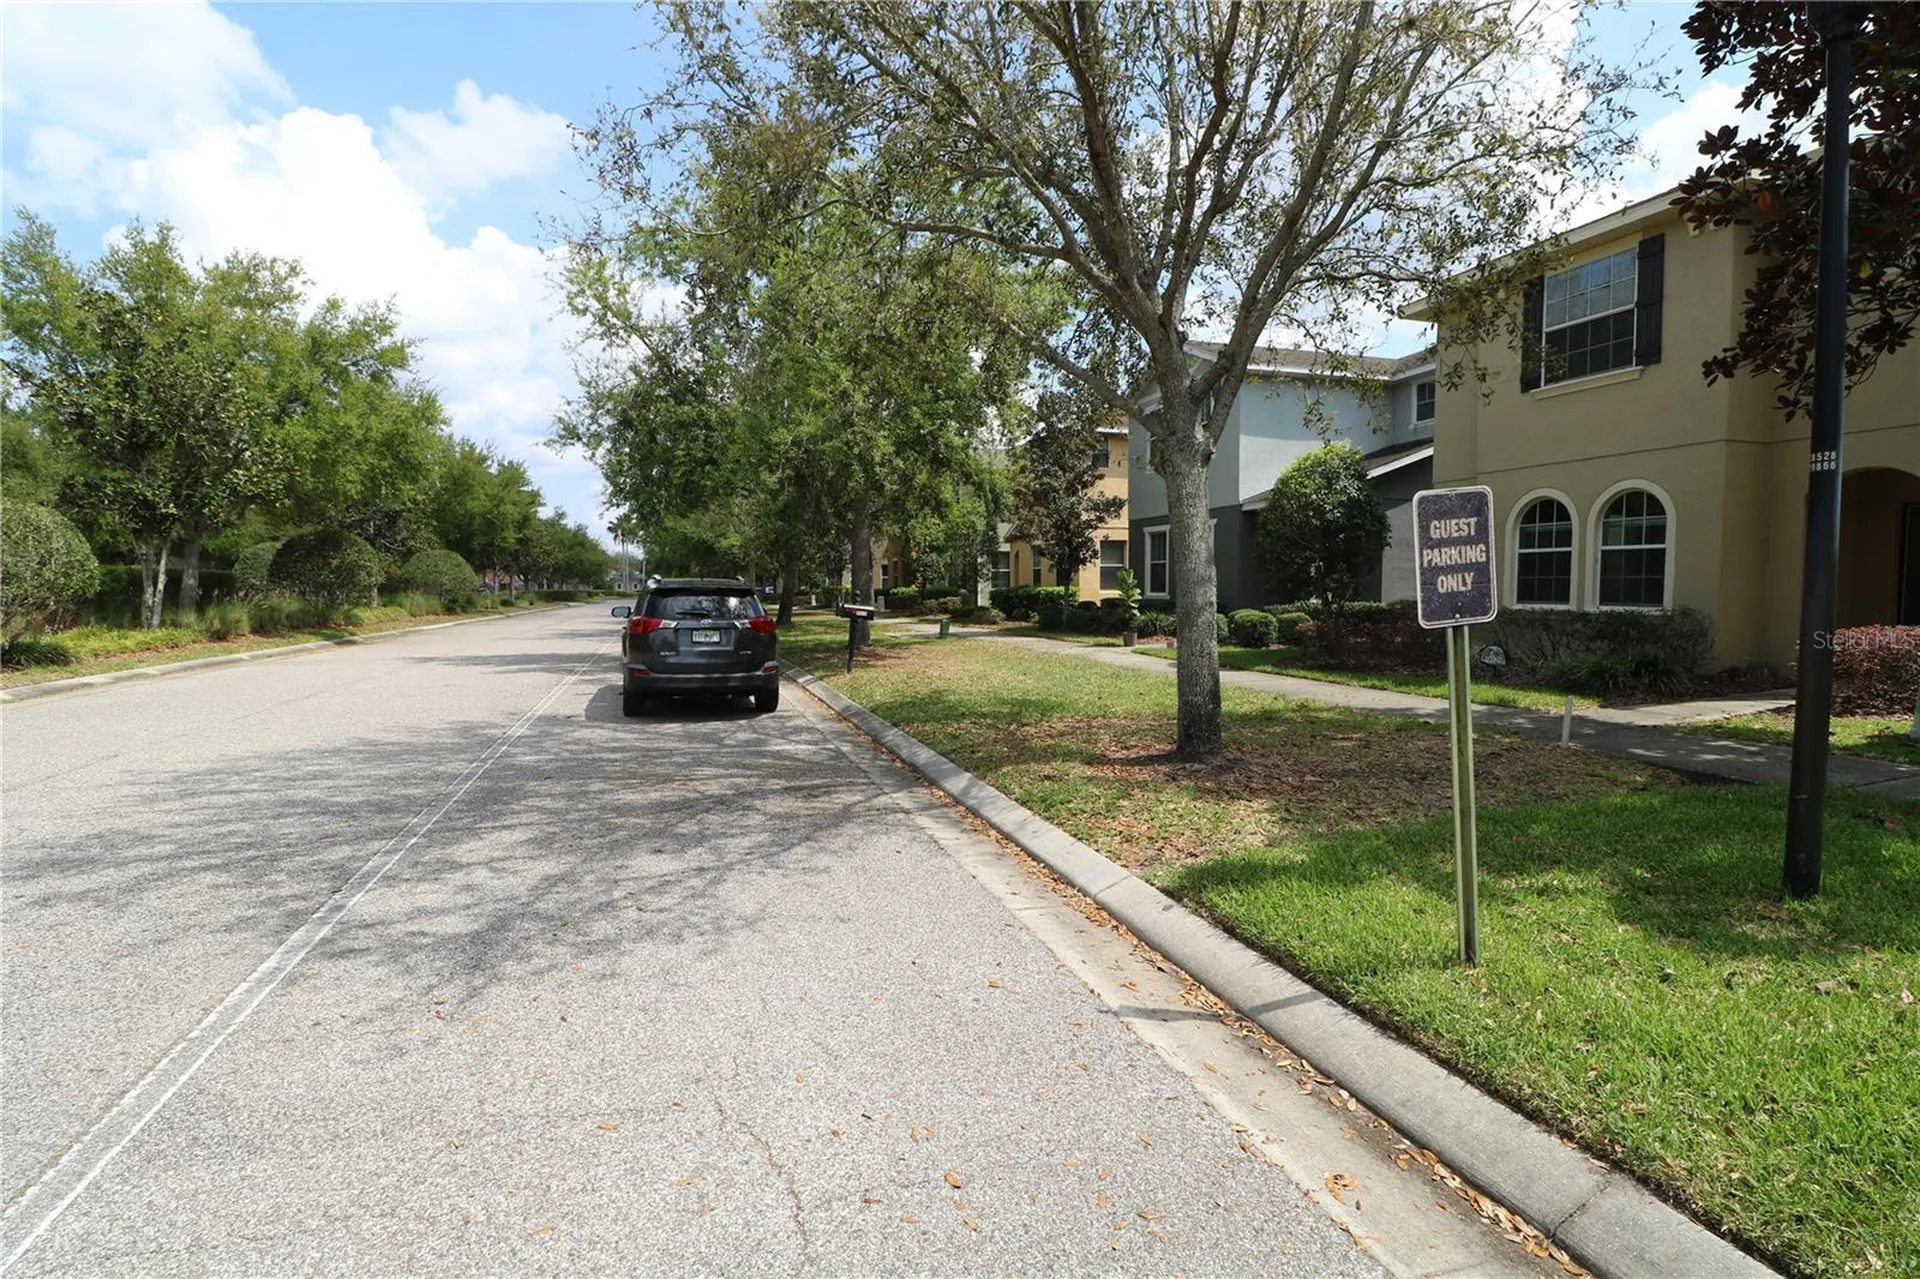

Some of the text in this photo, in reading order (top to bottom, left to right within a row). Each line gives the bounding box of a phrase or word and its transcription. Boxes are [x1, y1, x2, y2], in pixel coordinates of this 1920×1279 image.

[1430, 517, 1478, 539] GUEST
[1422, 544, 1487, 567] PARKING
[1436, 572, 1475, 594] ONLY
